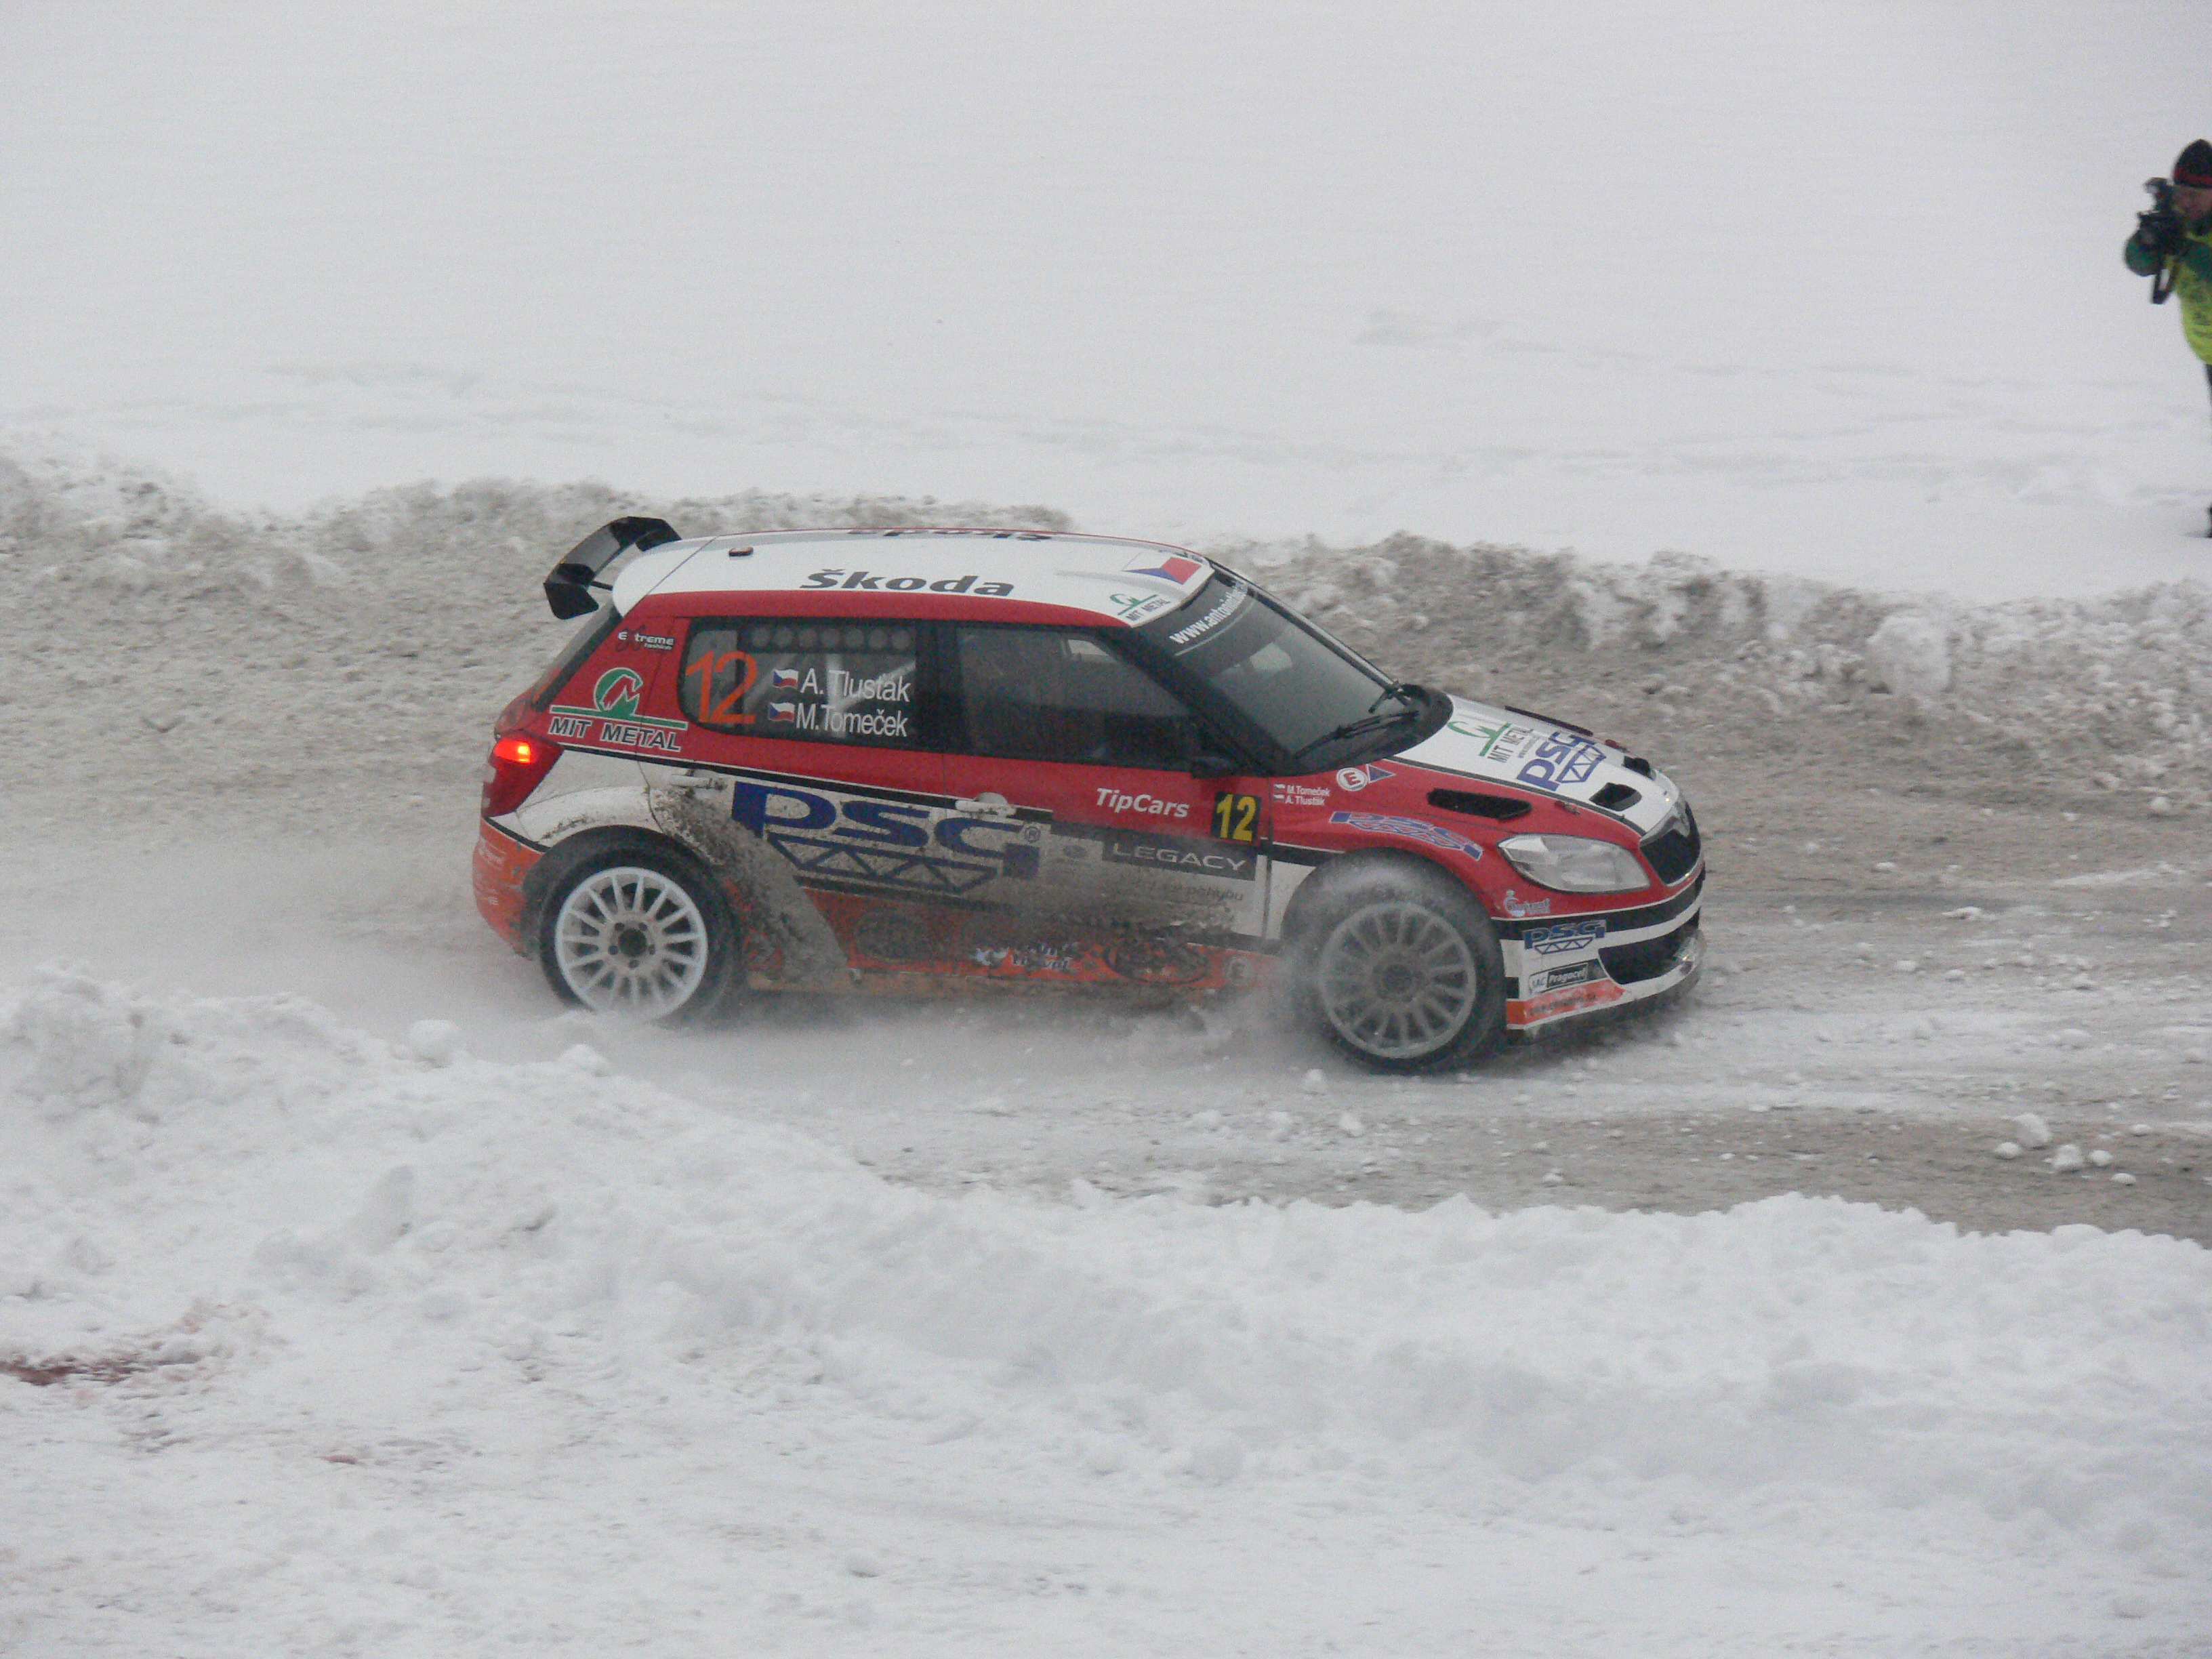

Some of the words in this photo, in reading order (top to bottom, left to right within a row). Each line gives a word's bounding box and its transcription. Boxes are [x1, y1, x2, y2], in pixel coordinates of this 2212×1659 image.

[799, 568, 1015, 596] Škoda
[685, 651, 758, 724] 12
[548, 716, 593, 738] MIT
[599, 722, 681, 752] METAL
[1097, 787, 1190, 818] TipCars
[1216, 792, 1258, 842] 12
[1113, 843, 1246, 872] LEGACY
